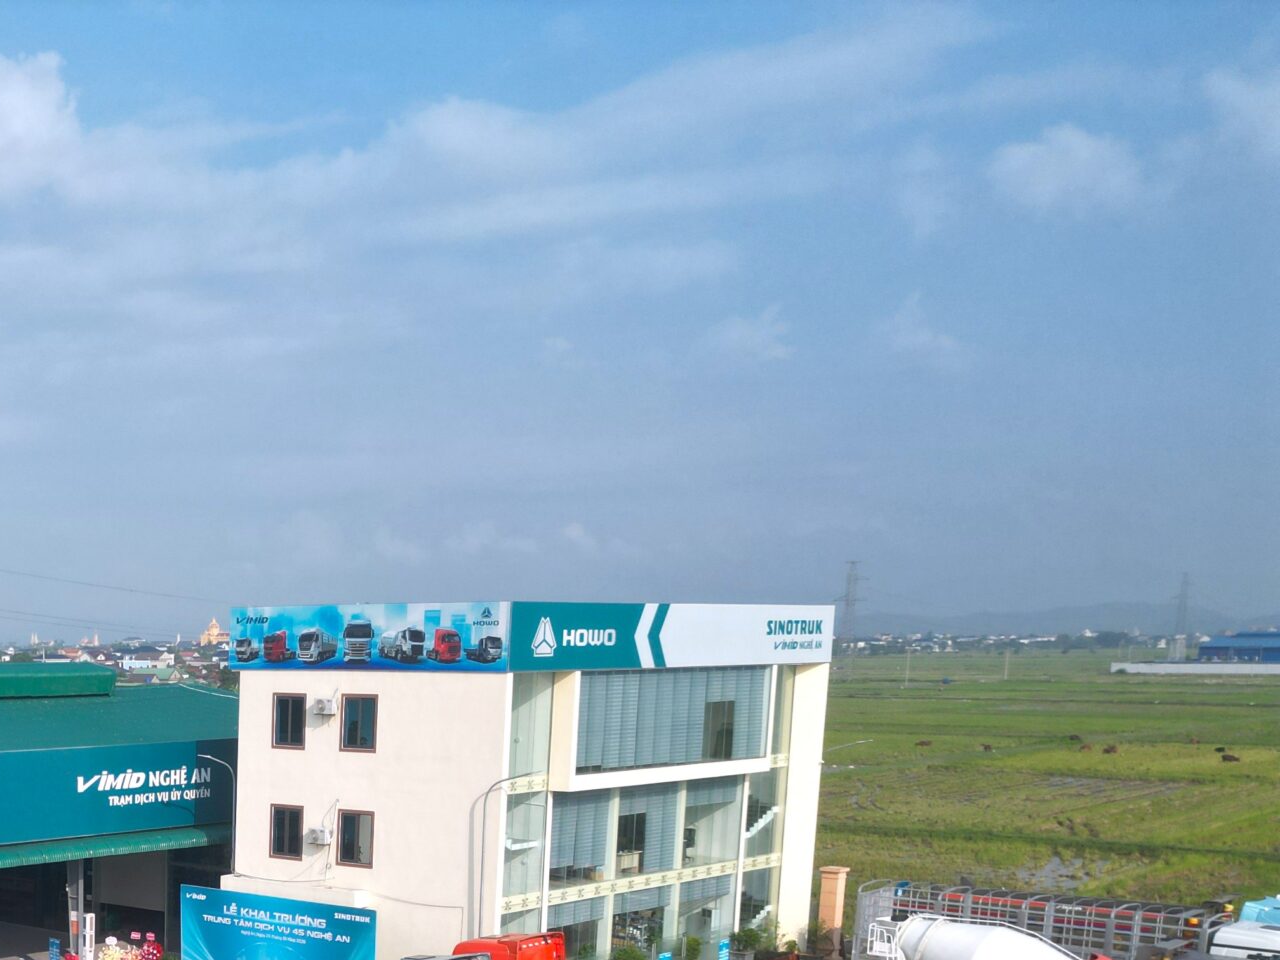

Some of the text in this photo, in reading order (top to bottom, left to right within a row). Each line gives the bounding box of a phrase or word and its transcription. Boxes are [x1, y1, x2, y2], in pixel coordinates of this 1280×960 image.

[766, 619, 823, 636] SINOTRUK
[562, 628, 616, 647] HOWO
[149, 765, 187, 787] NGHỆ
[191, 768, 211, 784] AN
[108, 794, 133, 808] TRẠM
[135, 794, 155, 806] DỊCH
[157, 792, 169, 803] VỤ
[240, 907, 269, 921] KHAI
[273, 911, 327, 928] TRƯƠNG
[334, 912, 370, 923] SINOTRUK
[202, 914, 231, 925] TRUNG
[234, 916, 253, 927] TÂM
[306, 930, 332, 942] NGHỆ
[335, 935, 351, 944] AN
